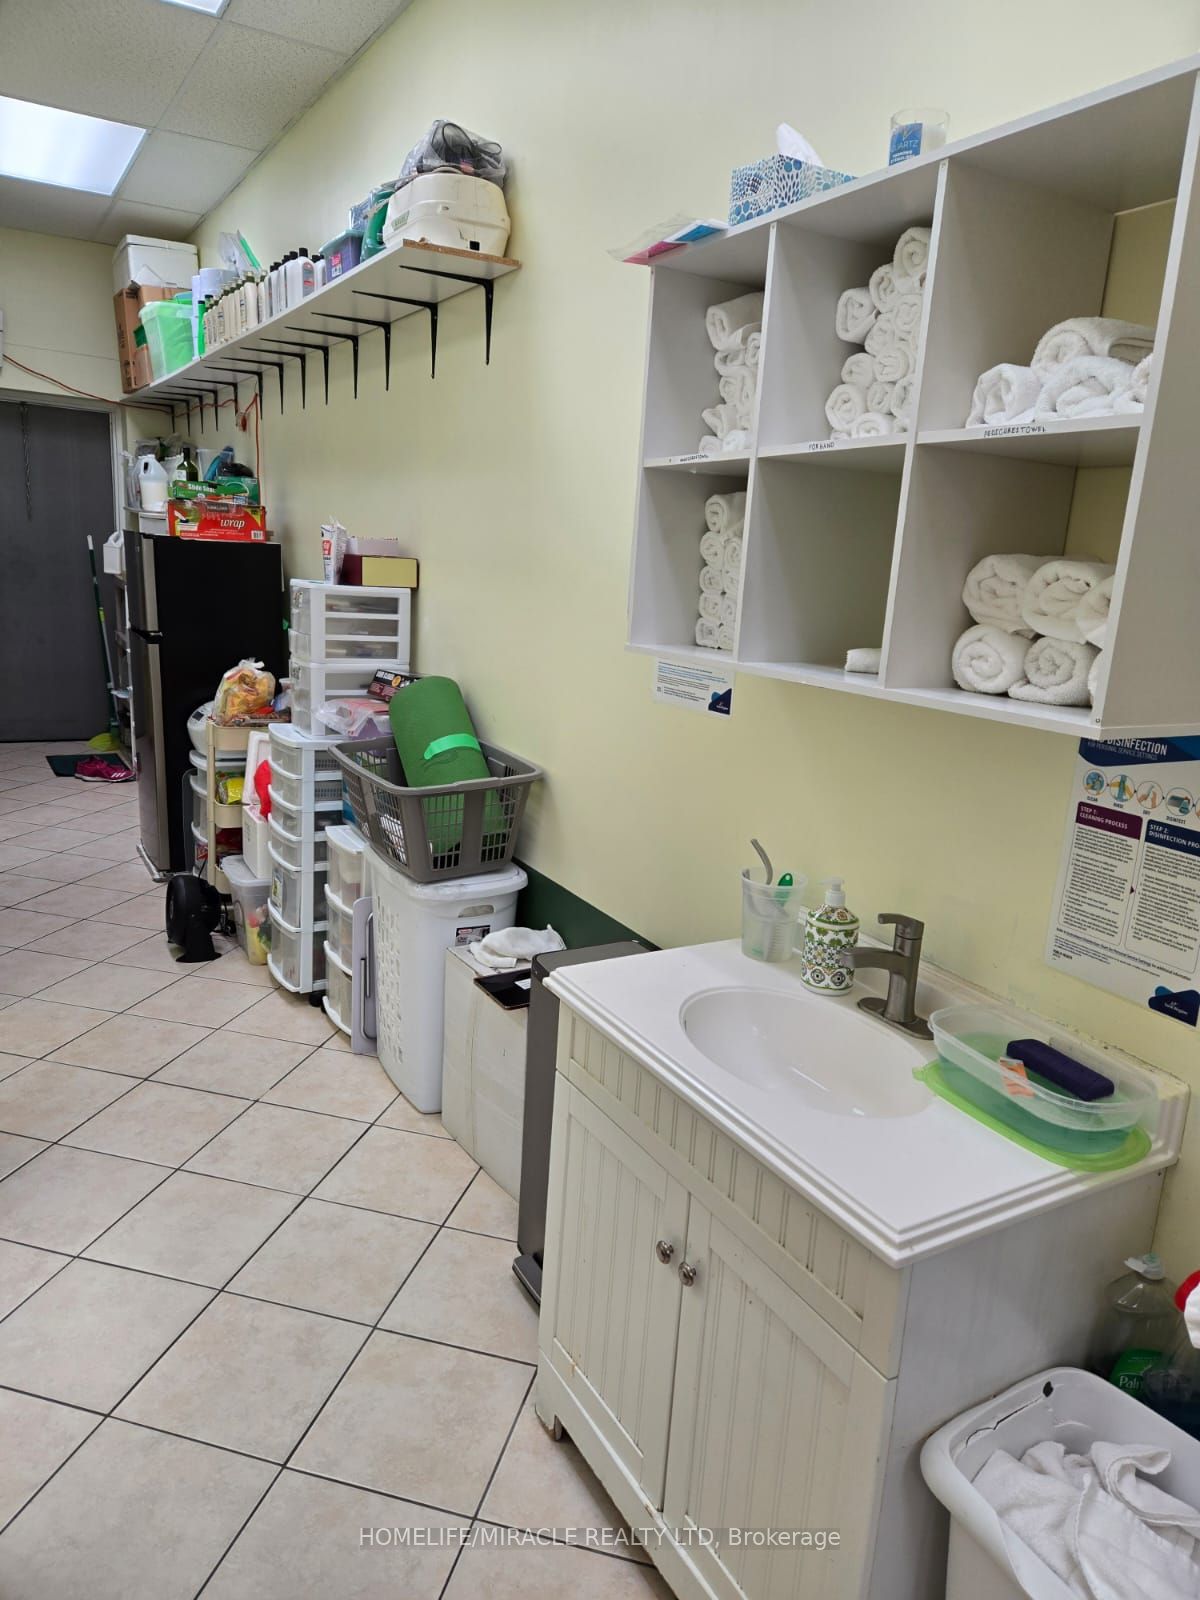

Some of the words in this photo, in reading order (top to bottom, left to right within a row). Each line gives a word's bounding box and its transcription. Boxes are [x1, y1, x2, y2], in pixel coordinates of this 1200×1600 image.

[220, 520, 245, 529] wrap
[1106, 739, 1168, 756] DISINFECTION
[1080, 812, 1104, 824] CLEANING
[1104, 818, 1128, 830] PROCESS
[1150, 824, 1163, 832] STEP
[1149, 832, 1187, 846] DISINFECTION
